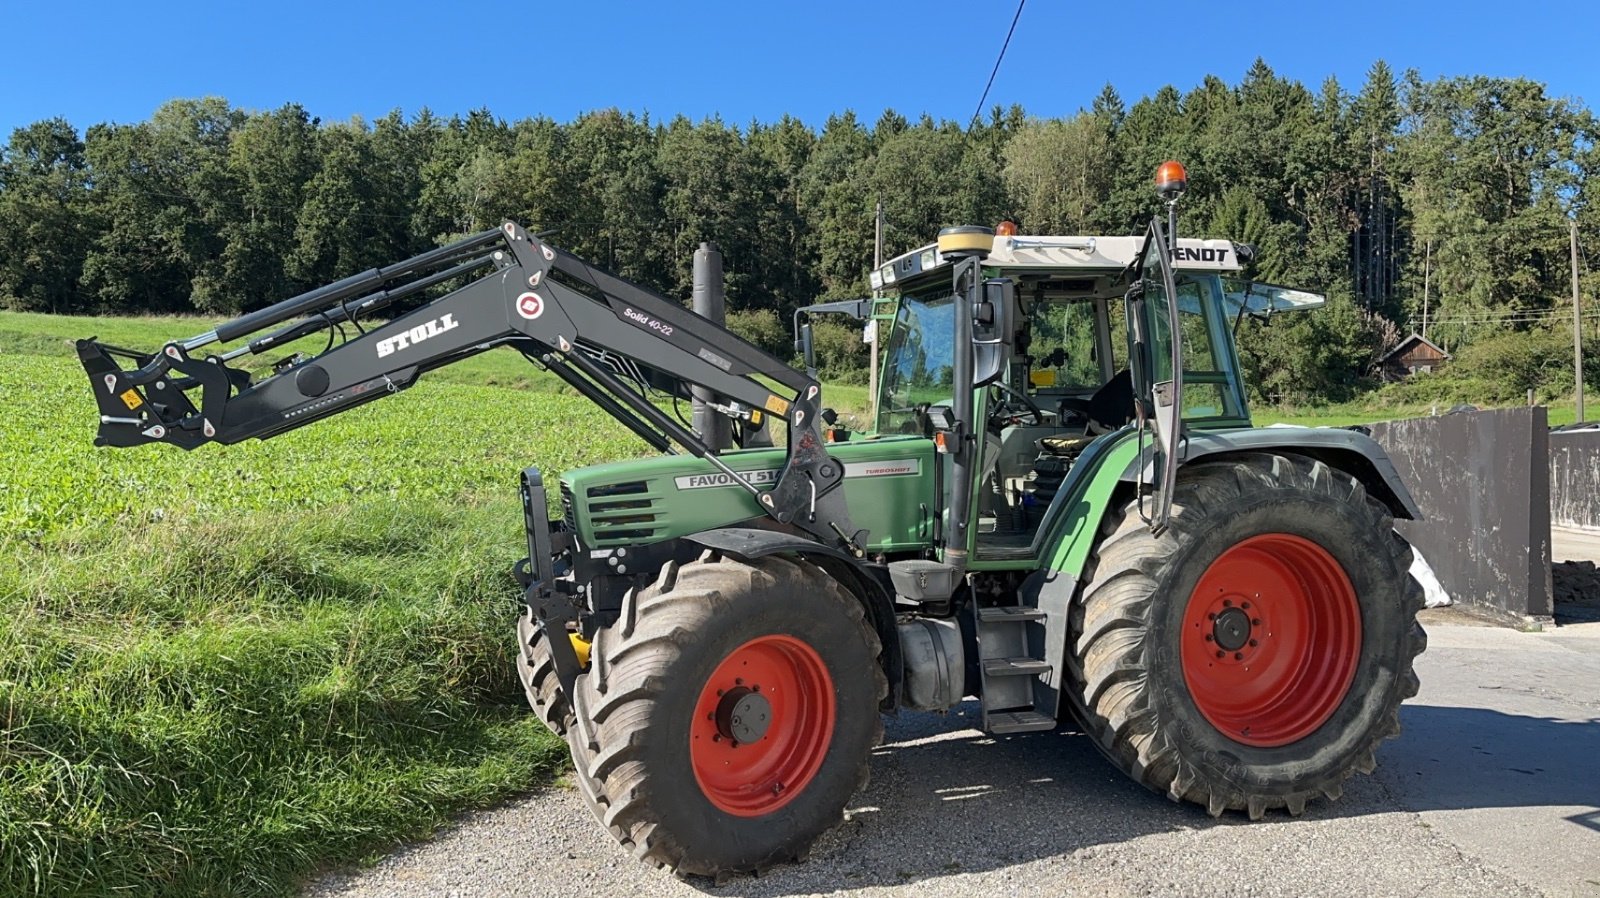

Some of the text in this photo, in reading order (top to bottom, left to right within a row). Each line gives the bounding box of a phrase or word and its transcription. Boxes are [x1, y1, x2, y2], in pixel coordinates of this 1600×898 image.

[376, 313, 459, 359] STOLL
[623, 308, 673, 336] Solid 40-22
[865, 467, 911, 475] TURBOSHIFT
